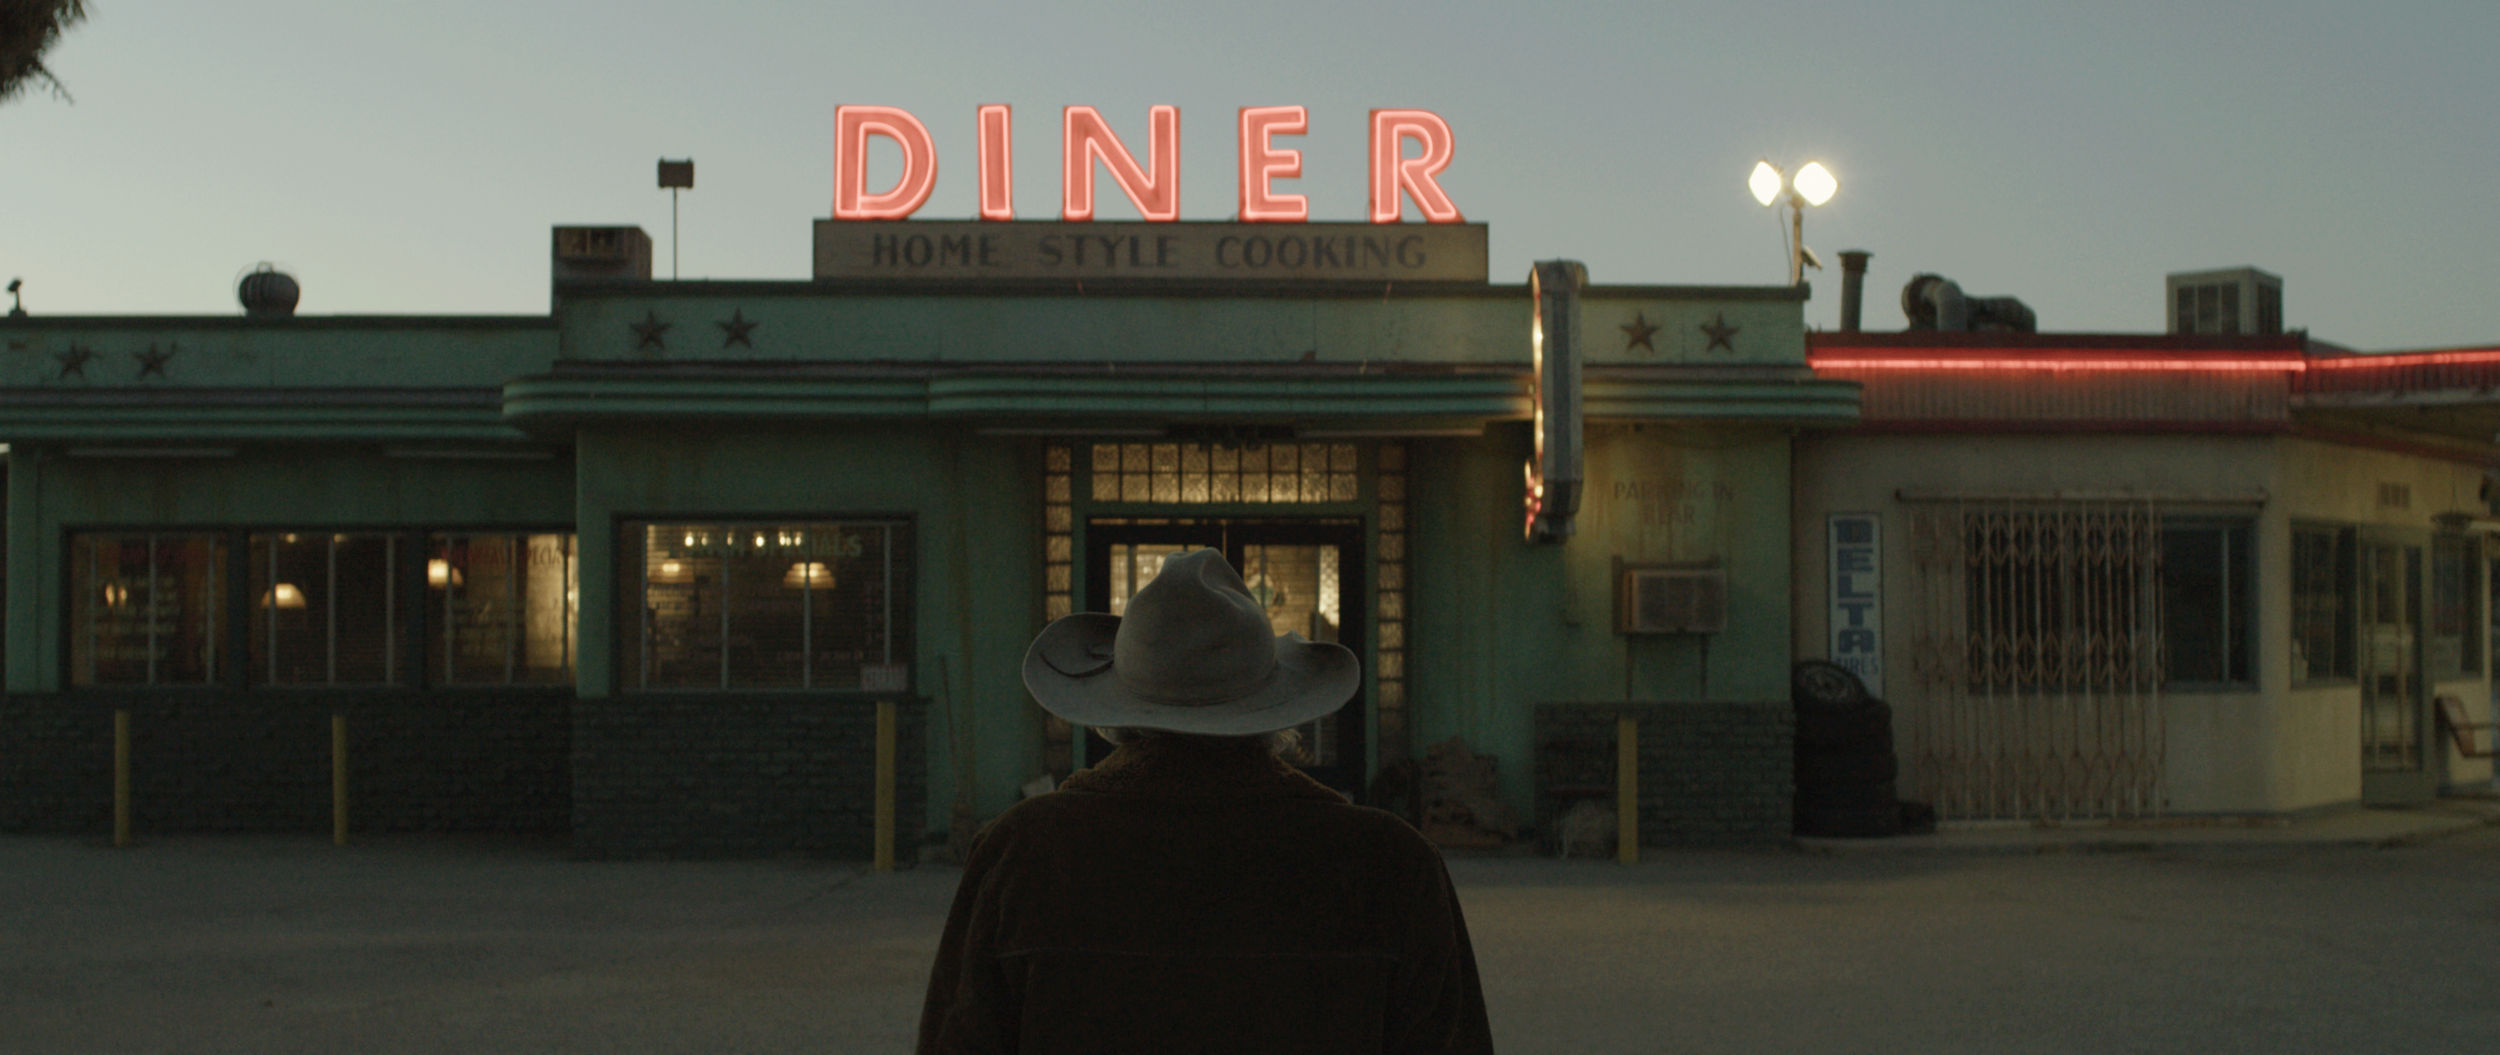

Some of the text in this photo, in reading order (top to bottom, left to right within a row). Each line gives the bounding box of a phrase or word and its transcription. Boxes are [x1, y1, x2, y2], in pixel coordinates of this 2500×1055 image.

[832, 104, 1464, 221] DINER
[872, 234, 1427, 269] HOME STYLE COOKING
[1613, 480, 1735, 502] PARKING IN
[1643, 503, 1695, 525] REAR
[752, 534, 863, 557] SPECIALS
[1834, 519, 1875, 653] DELTA
